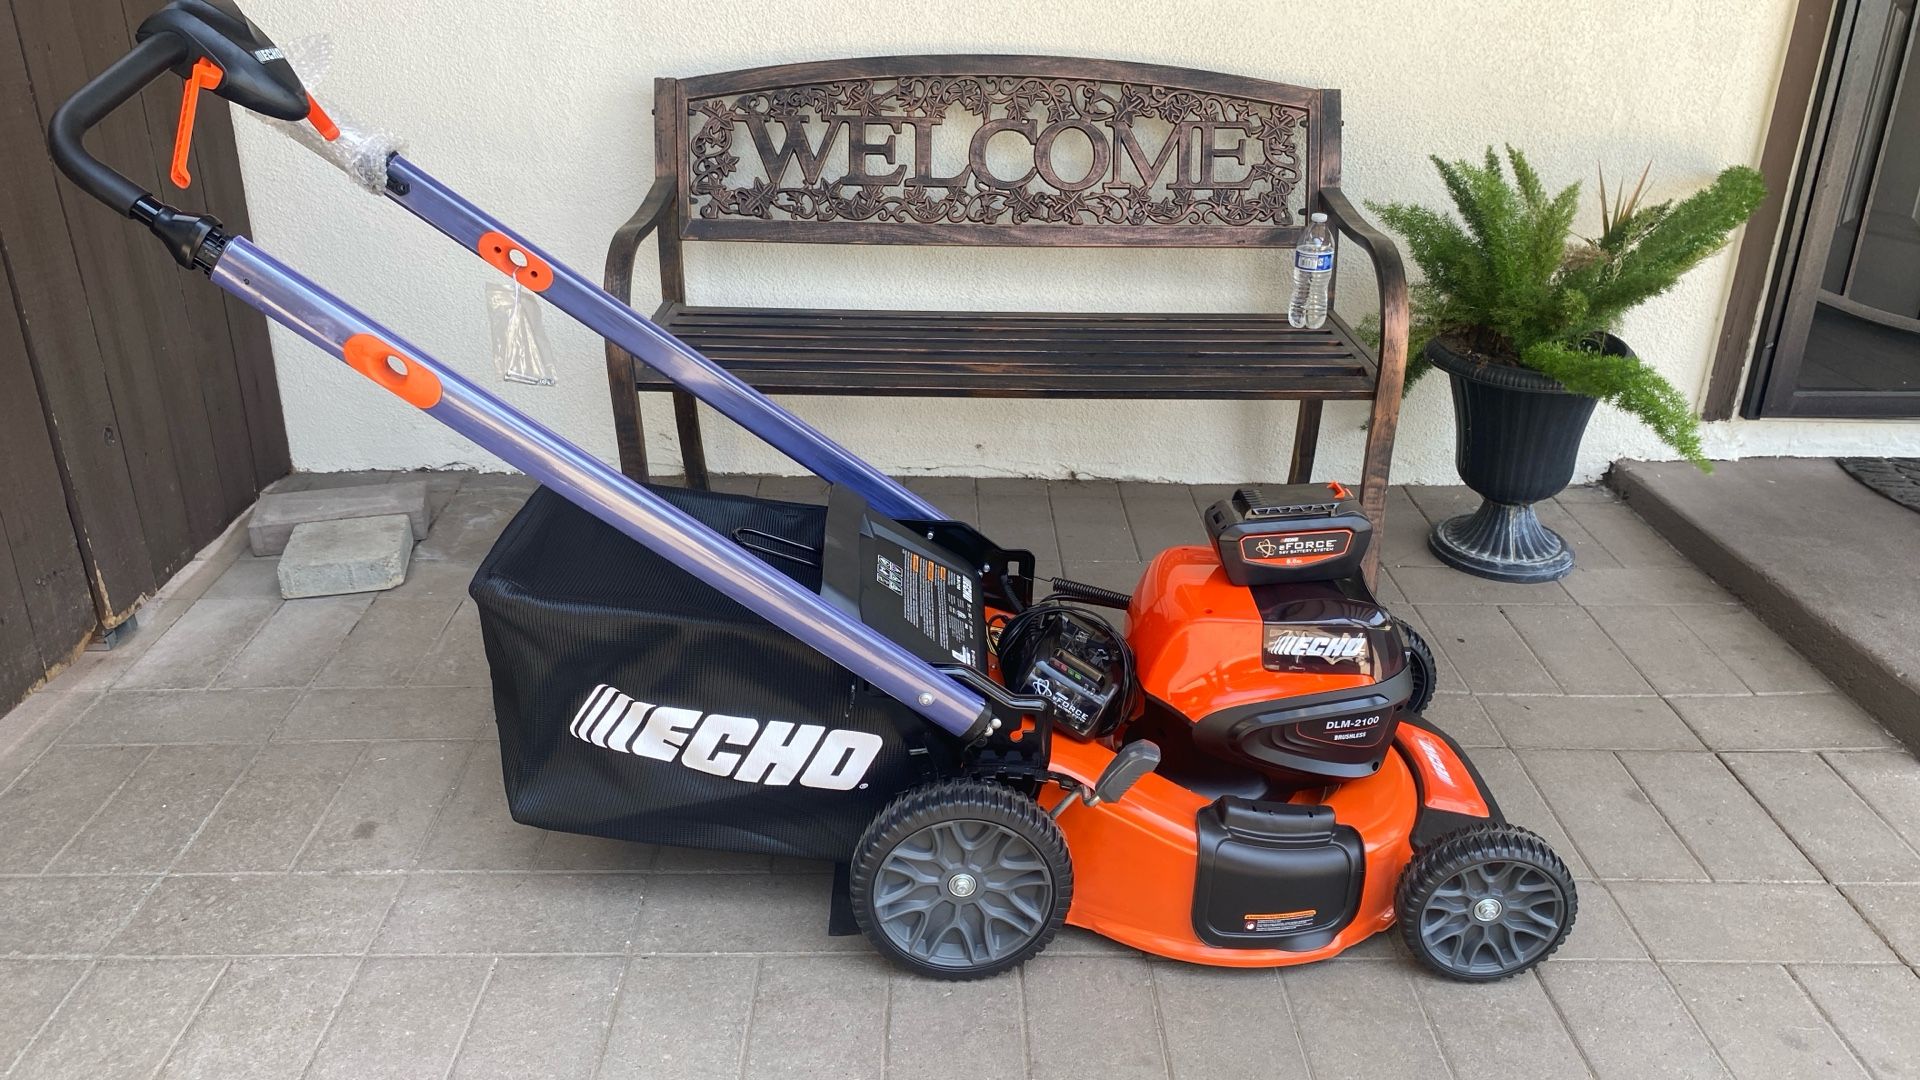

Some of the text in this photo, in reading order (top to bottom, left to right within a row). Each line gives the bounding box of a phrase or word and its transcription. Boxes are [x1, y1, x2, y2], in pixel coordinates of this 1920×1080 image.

[735, 113, 1257, 191] WELCOME
[1288, 636, 1367, 657] ECHO
[1326, 715, 1380, 730] DLM-2100
[628, 702, 882, 791] ECHO
[1333, 731, 1367, 741] BRUSHLESS
